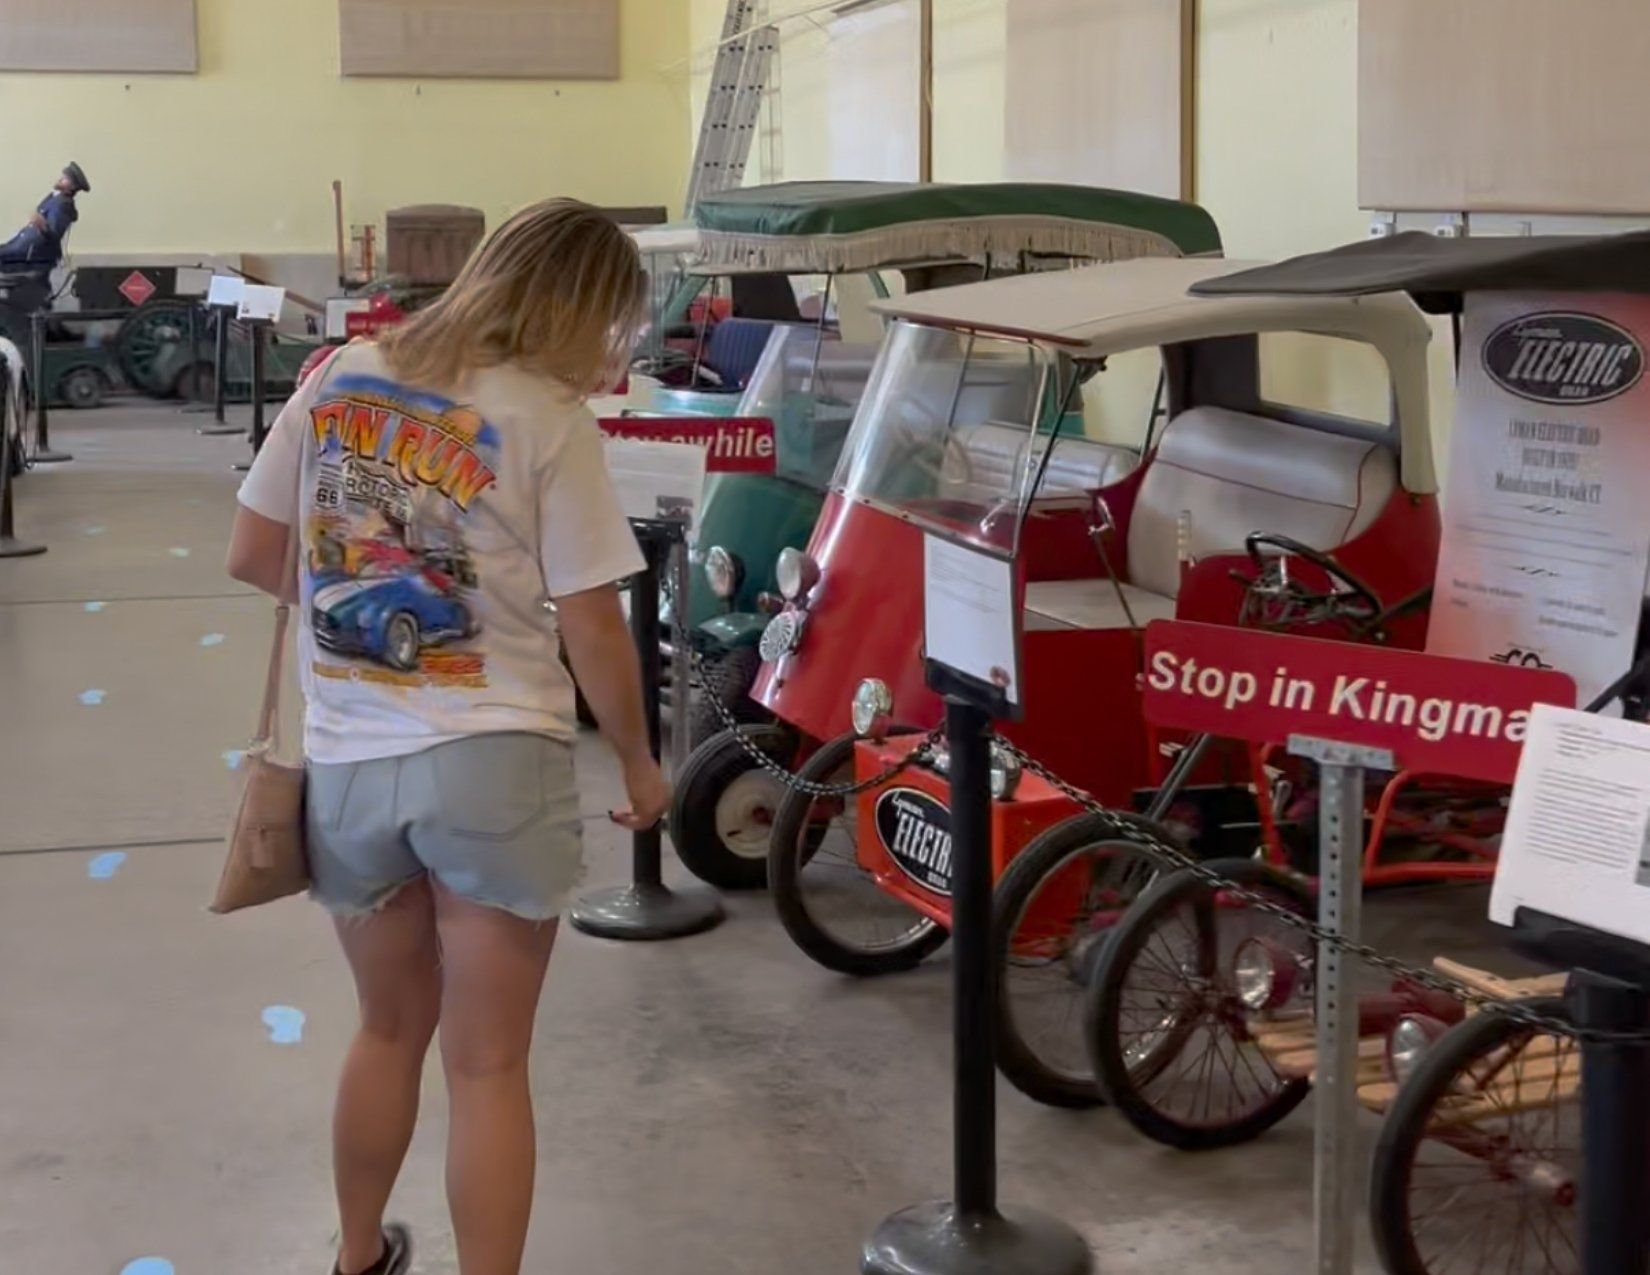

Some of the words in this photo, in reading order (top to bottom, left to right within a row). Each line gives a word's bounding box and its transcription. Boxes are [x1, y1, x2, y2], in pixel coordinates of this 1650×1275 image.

[316, 487, 339, 505] 66
[1148, 651, 1258, 710] Stop
[1268, 667, 1315, 711] in
[1328, 674, 1532, 741] Kingma
[893, 812, 952, 878] ELECTR
